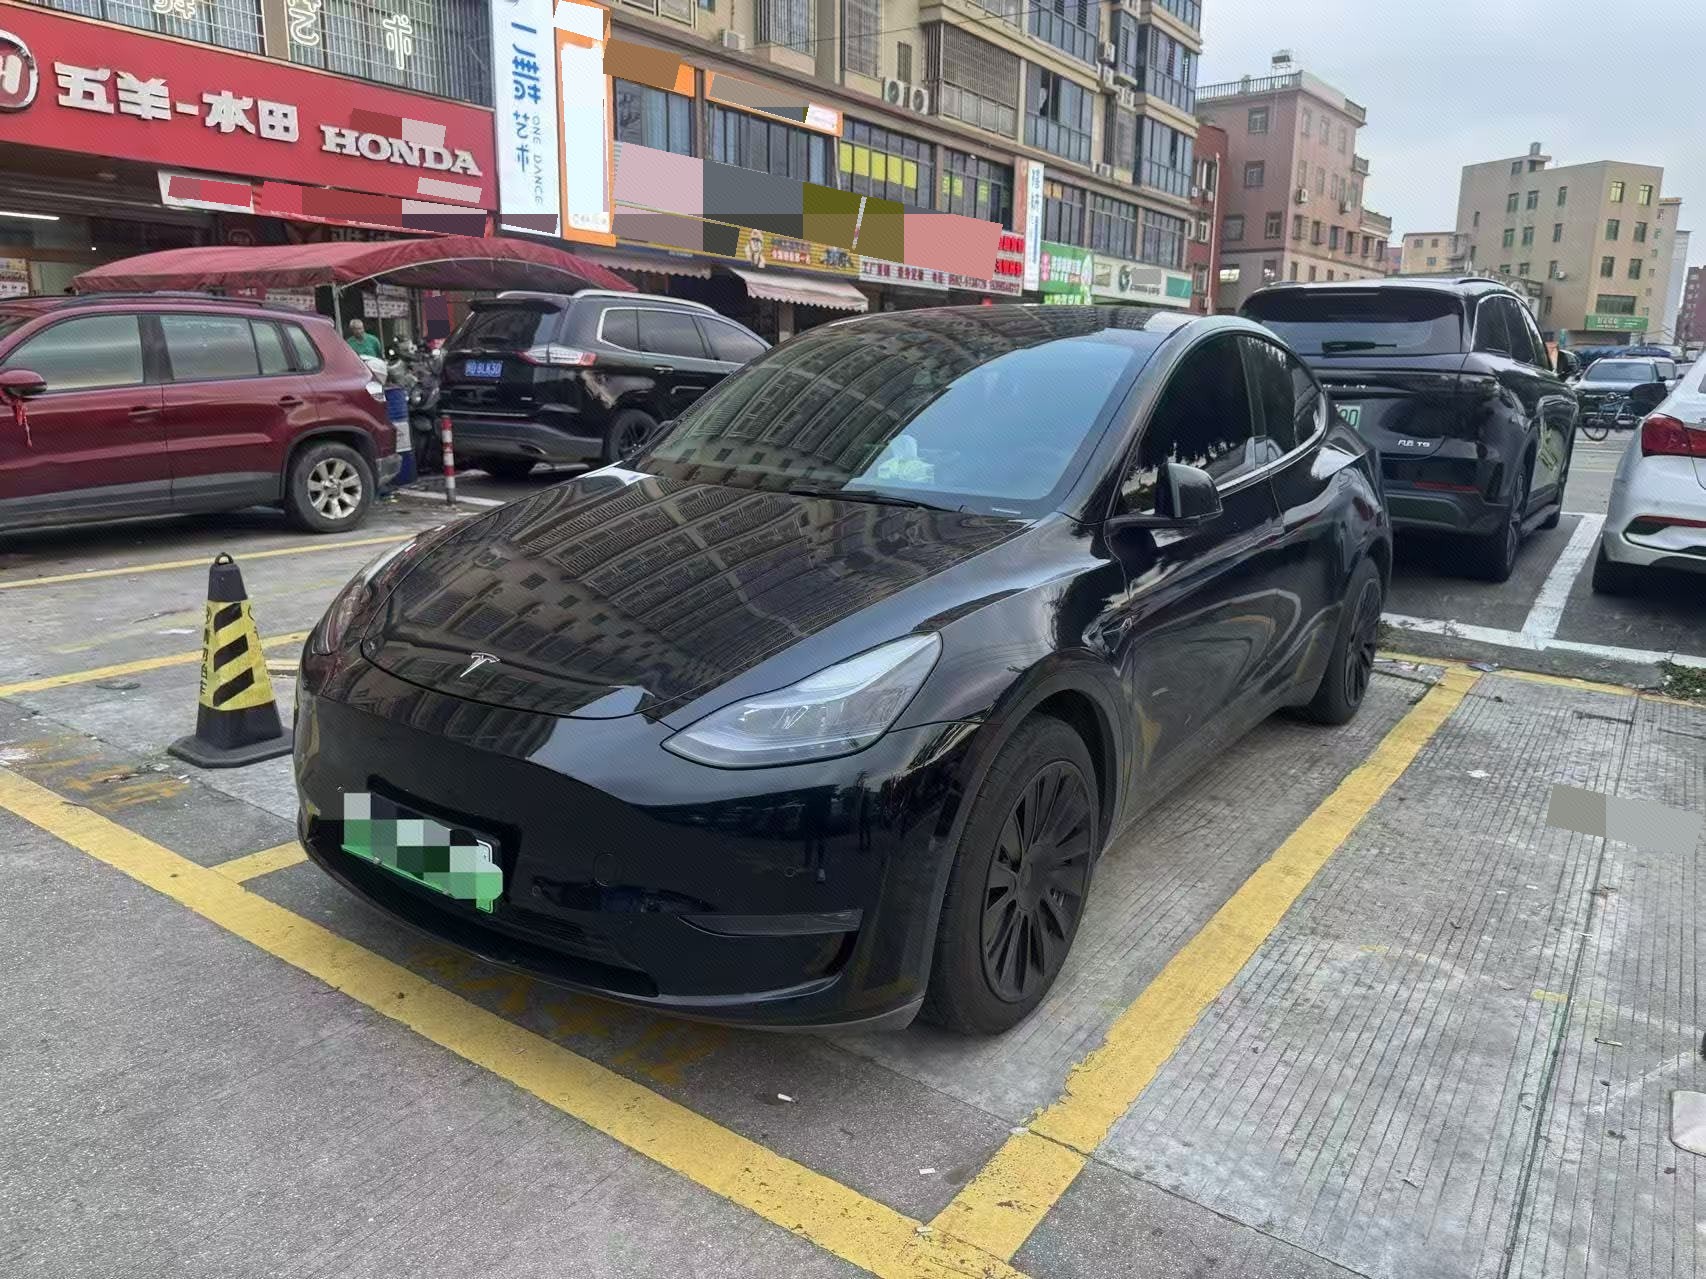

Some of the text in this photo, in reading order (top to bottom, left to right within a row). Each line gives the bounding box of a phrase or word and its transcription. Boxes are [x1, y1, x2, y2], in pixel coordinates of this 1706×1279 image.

[319, 123, 483, 177] HONDA
[532, 115, 544, 206] ONE DANCE
